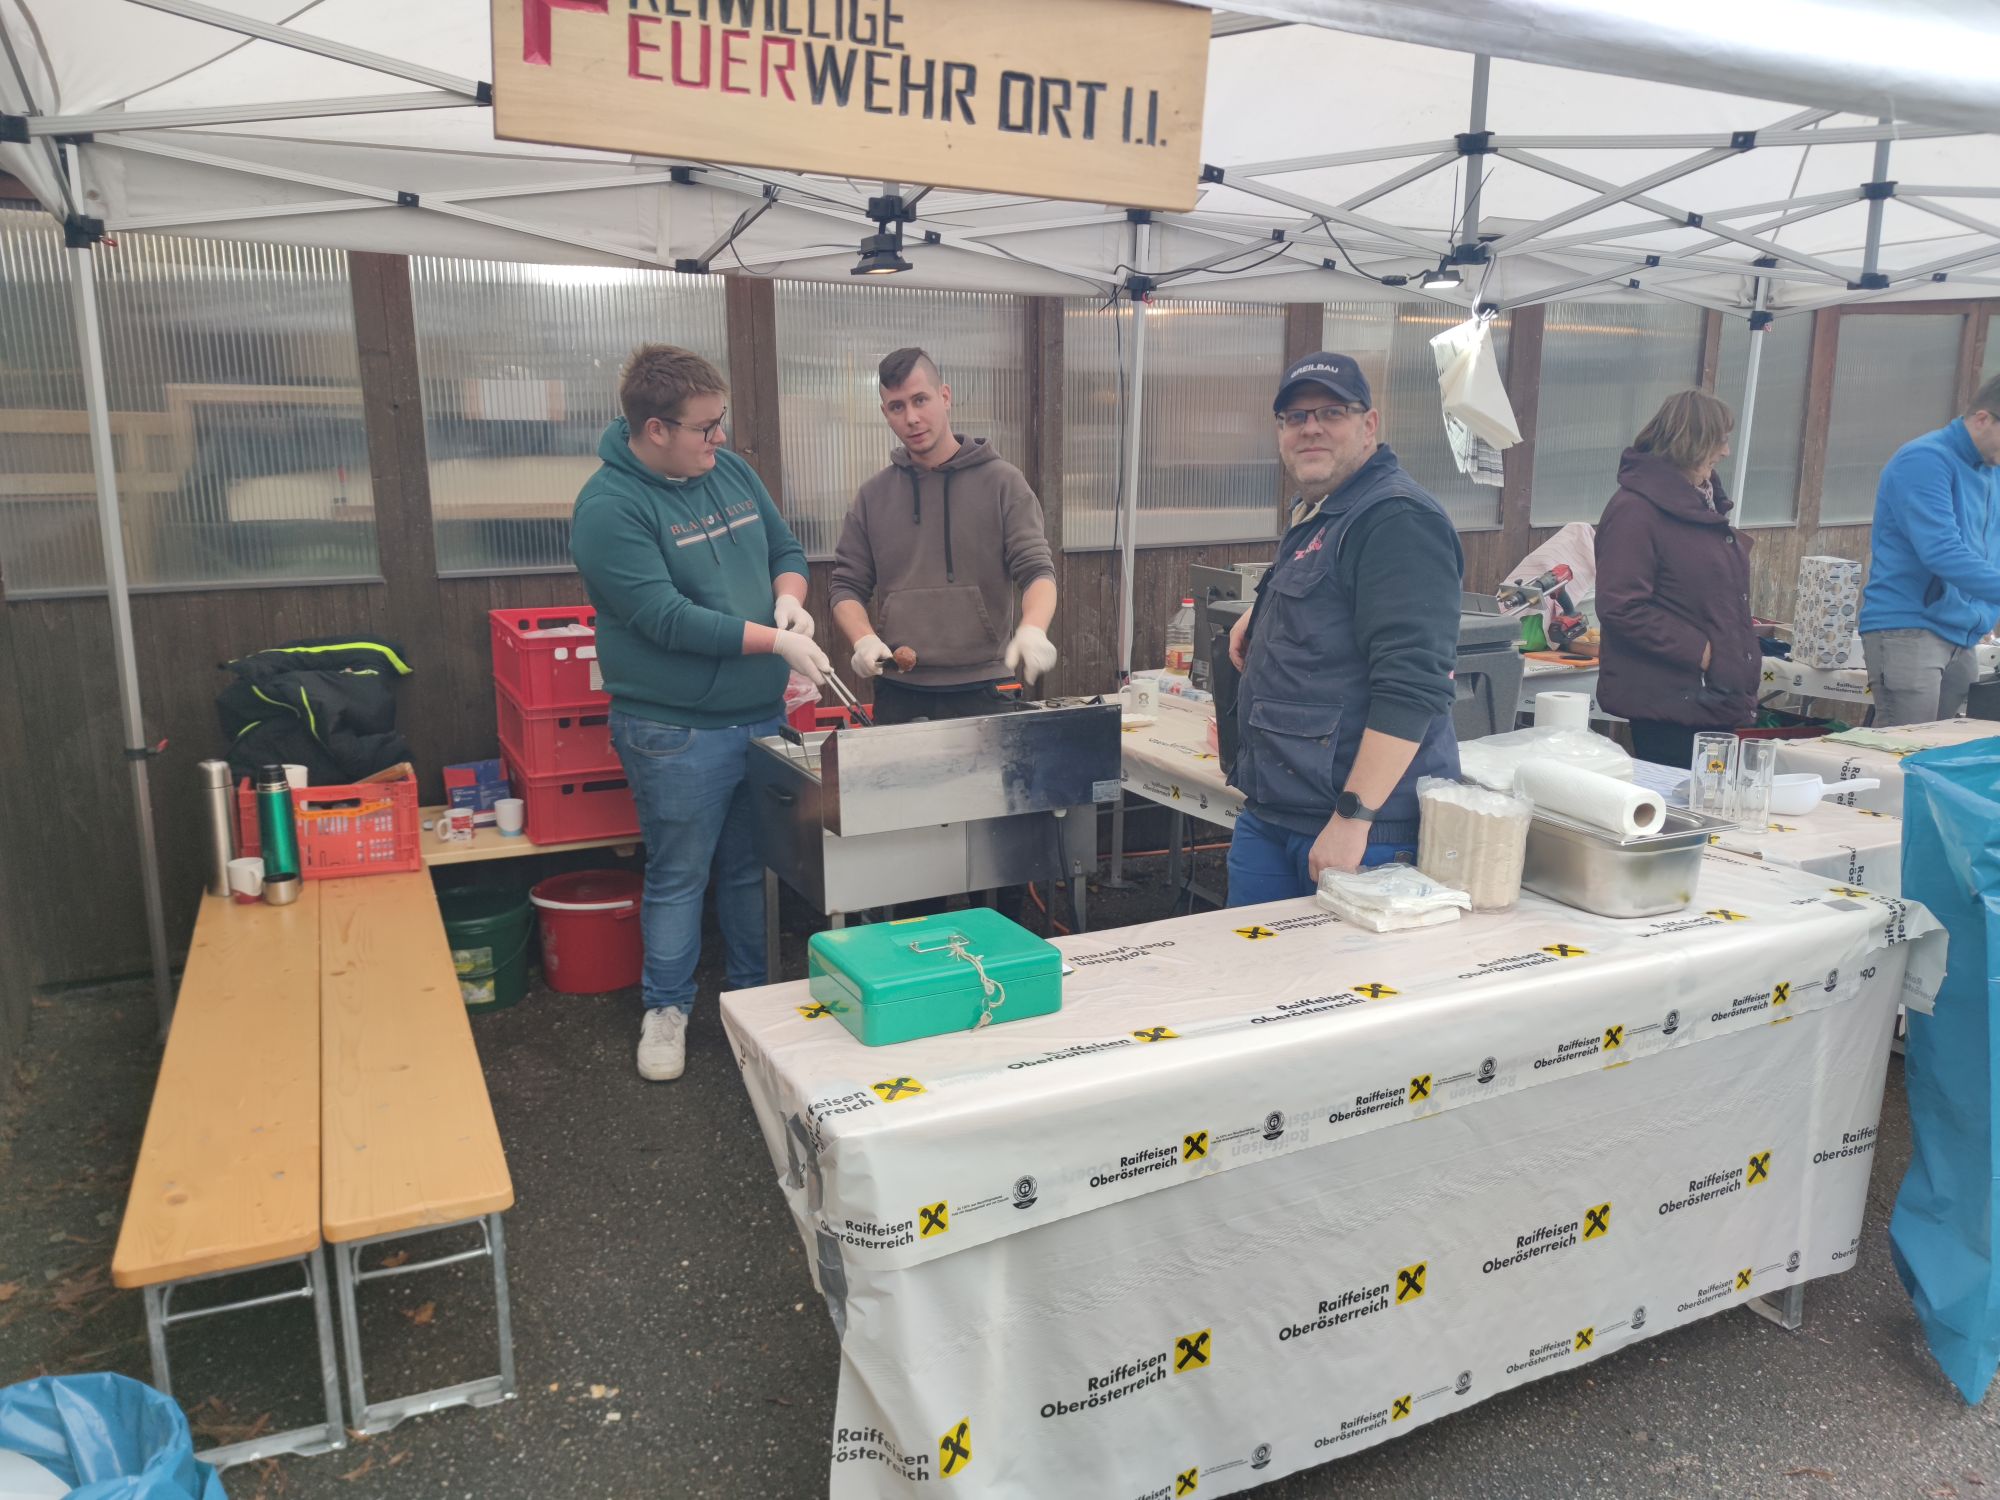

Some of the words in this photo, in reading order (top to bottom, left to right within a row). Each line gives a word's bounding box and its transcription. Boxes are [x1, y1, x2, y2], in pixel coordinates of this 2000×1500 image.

[628, 0, 905, 50] LLIGE
[998, 70, 1107, 140] ORT
[1068, 940, 1176, 962] Obersterreich
[1250, 998, 1367, 1025] Oberösterreich
[1276, 992, 1355, 1011] Raiffeisen
[1711, 1000, 1769, 1022] Oberösterreich
[1732, 991, 1771, 1008] Raiffeisen
[1533, 1045, 1599, 1070] Oberösterreich
[1557, 1035, 1601, 1054] Raiffeisen
[1355, 1086, 1406, 1107] Raiffeisen
[1328, 1097, 1405, 1125] Oberösterreich
[1842, 1125, 1878, 1145] Raiffei
[1120, 1144, 1178, 1168] Raiffeisen
[1813, 1141, 1876, 1164] Oberösterr
[1089, 1155, 1178, 1188] Oberösterreich
[1688, 1167, 1743, 1193] Raiffeisen
[1658, 1179, 1741, 1216] Oberösterreich
[845, 1218, 913, 1238] Raiffeisen
[1516, 1221, 1578, 1249] Raiffeisen
[1482, 1233, 1577, 1274] Oberösterreich
[1318, 1283, 1390, 1314] Raiffeisen
[1677, 1287, 1732, 1313] Oberösterreich
[1697, 1279, 1733, 1298] Raiffeisen
[1278, 1296, 1389, 1341] Oberösterreich
[1506, 1347, 1571, 1374] Oberösterreich
[1528, 1338, 1572, 1358] Raiffeisen
[1087, 1352, 1167, 1392] Raiffeisen
[1040, 1366, 1167, 1419] Oberösterreich
[1340, 1408, 1389, 1431] Raiffeisen
[837, 1426, 929, 1466] Raiffeisen
[1314, 1418, 1388, 1449] Oberösterreich
[831, 1445, 930, 1482] österreich
[1136, 1485, 1171, 1500] feisen
